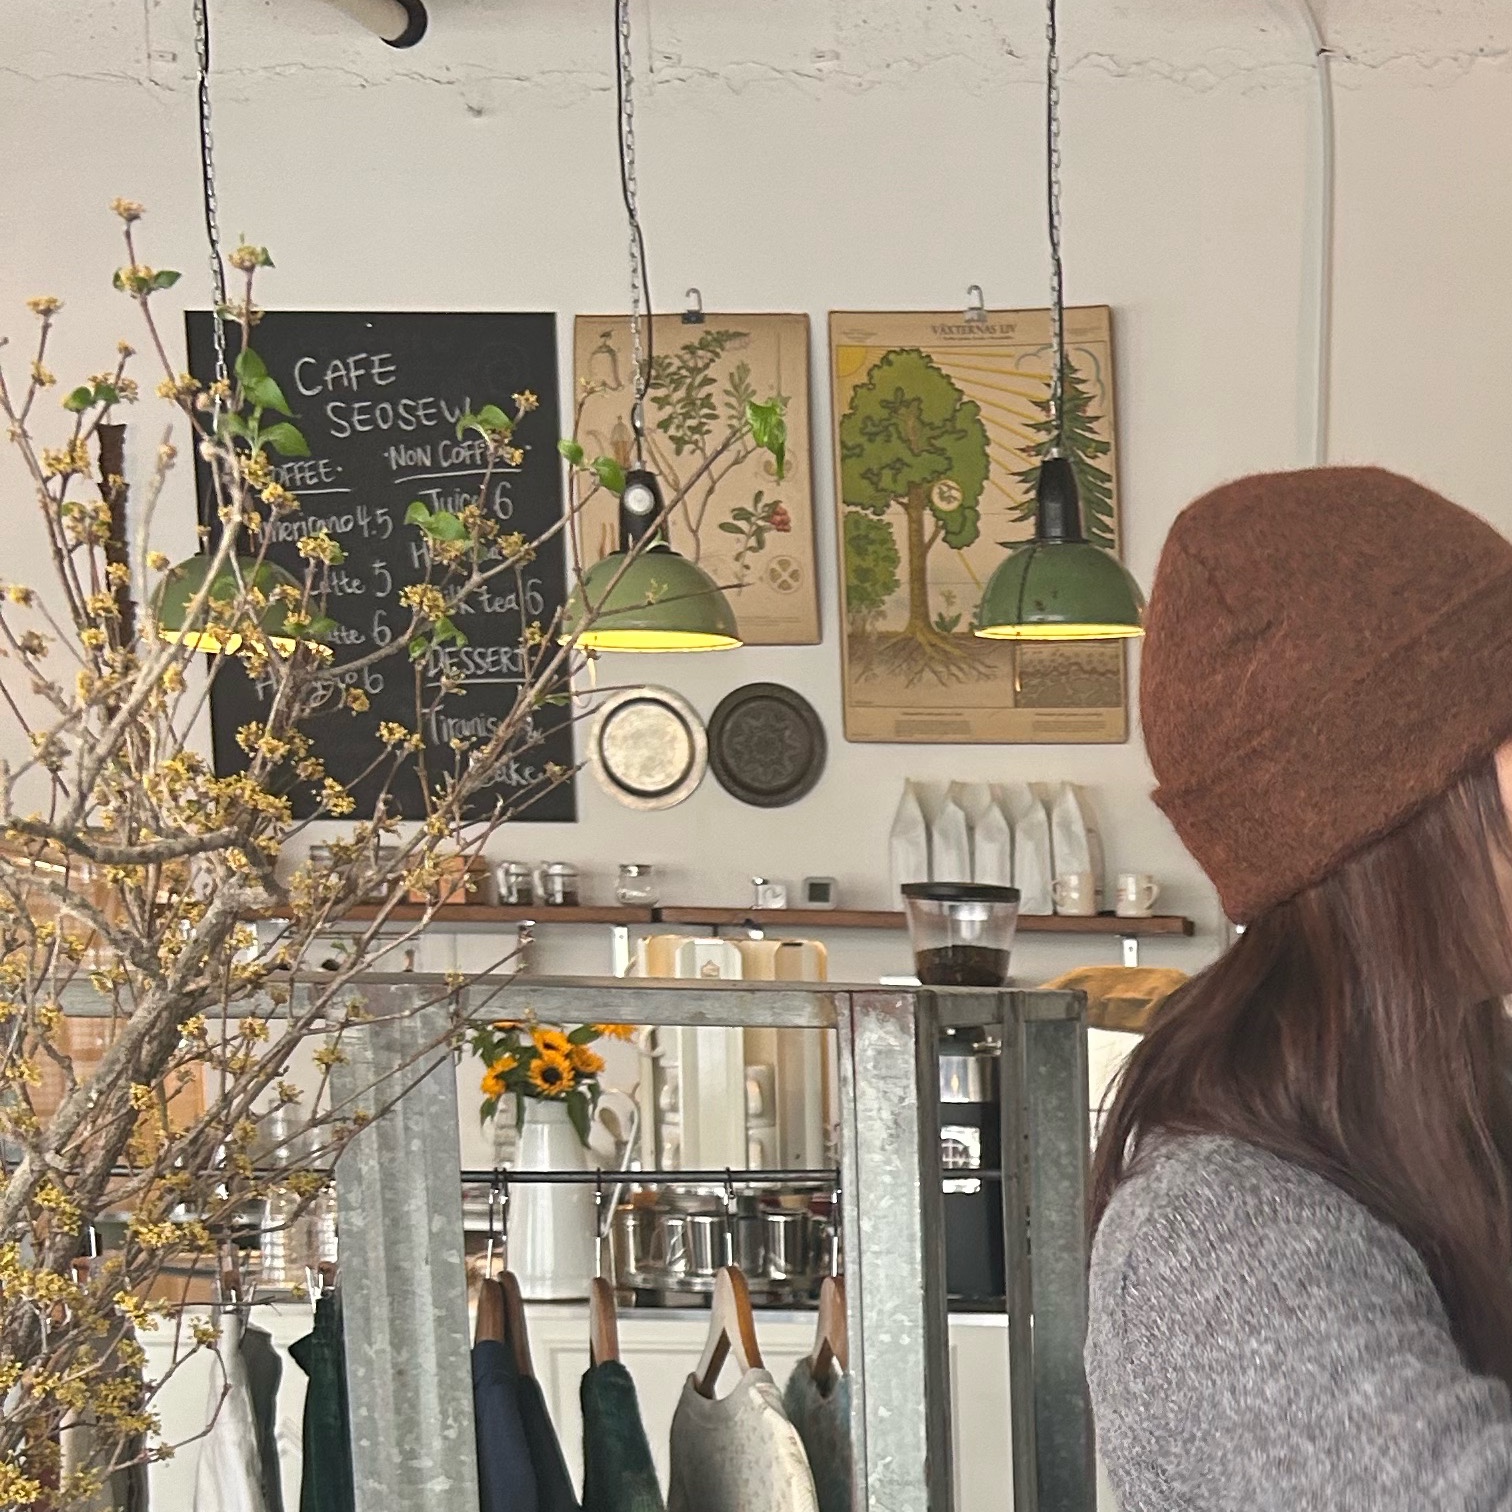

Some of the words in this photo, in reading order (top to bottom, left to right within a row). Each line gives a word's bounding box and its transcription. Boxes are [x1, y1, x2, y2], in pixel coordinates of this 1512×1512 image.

[294, 353, 397, 397] CAFE
[271, 459, 337, 487] OFFEE
[493, 481, 513, 521] 6
[257, 512, 354, 544] mericano
[356, 504, 393, 540] 4.5
[372, 559, 392, 598] 5
[525, 578, 545, 615] 6
[373, 609, 392, 647] 6
[365, 664, 385, 694] 6
[421, 704, 498, 746] Tiramis
